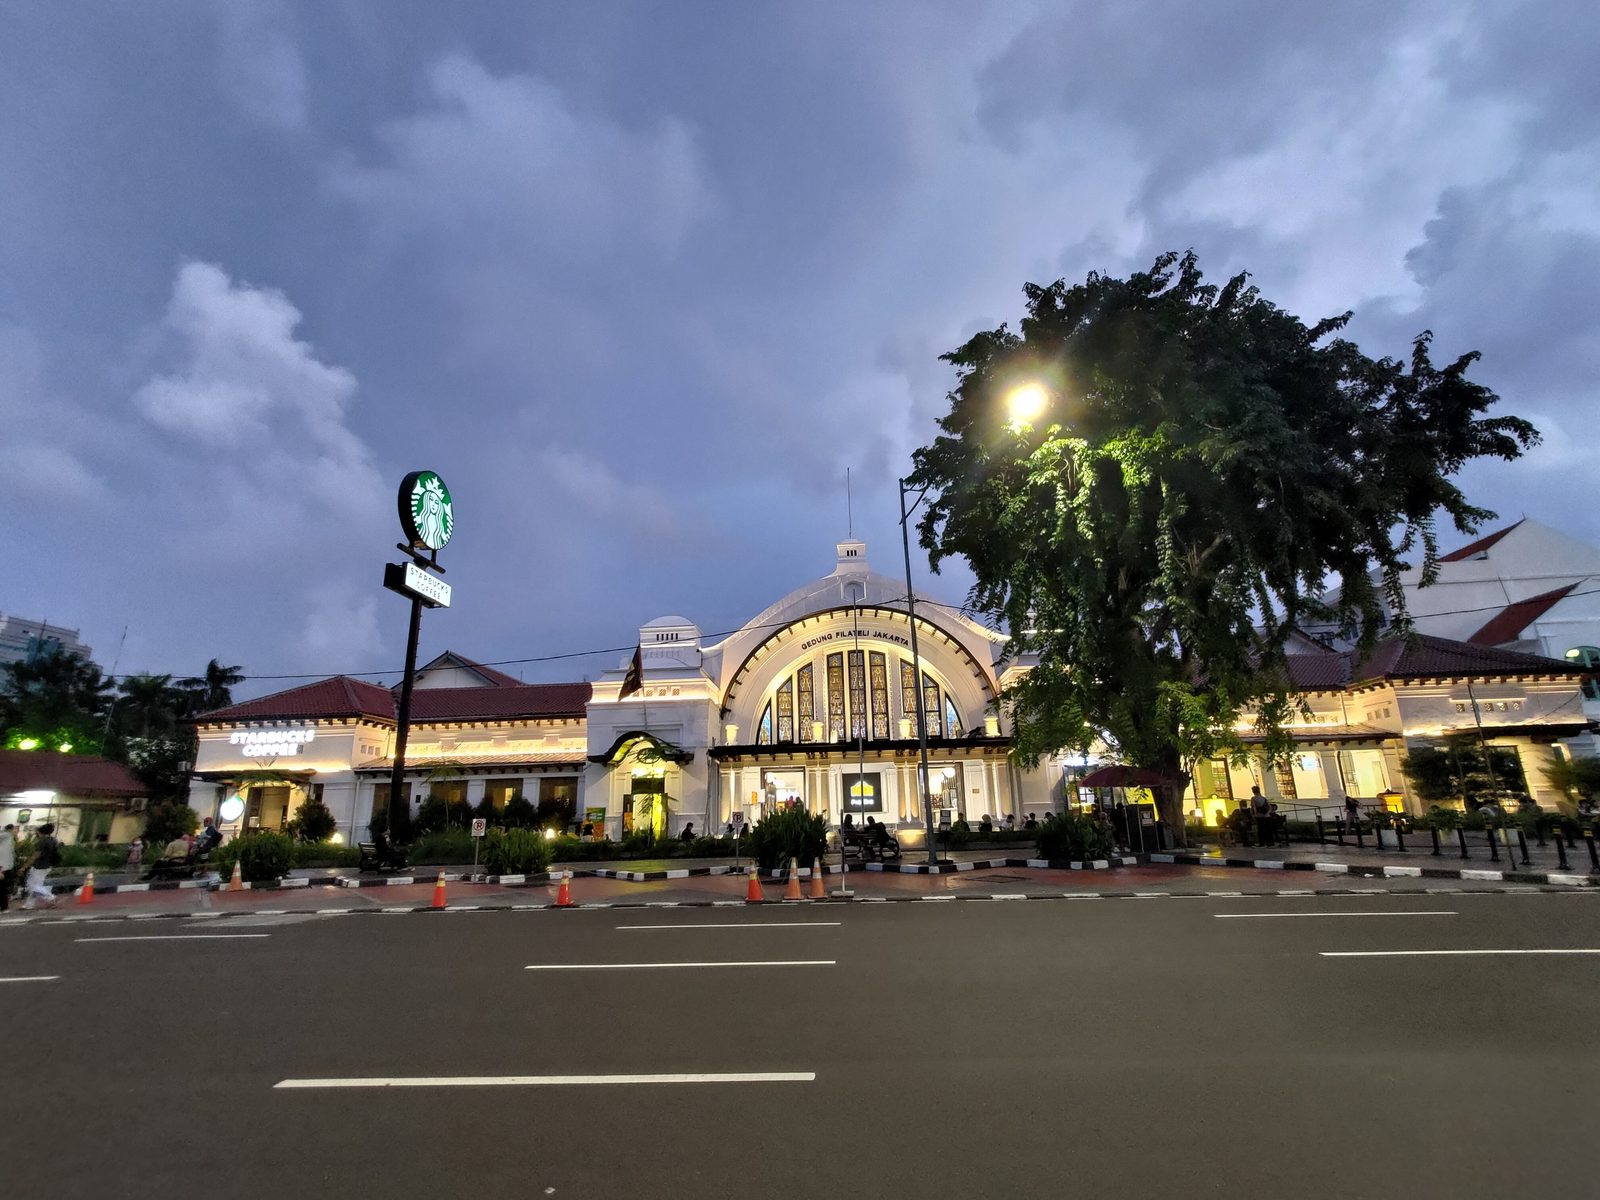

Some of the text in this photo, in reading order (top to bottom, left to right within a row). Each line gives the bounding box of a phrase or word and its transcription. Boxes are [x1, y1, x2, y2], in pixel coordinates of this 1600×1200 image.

[410, 567, 448, 594] STARBUCKS
[417, 581, 440, 599] COFFEE
[801, 630, 909, 650] GEDUNG FILATELI JAKARTA
[230, 730, 315, 744] STARBUCKS
[243, 744, 297, 756] COFFEE
